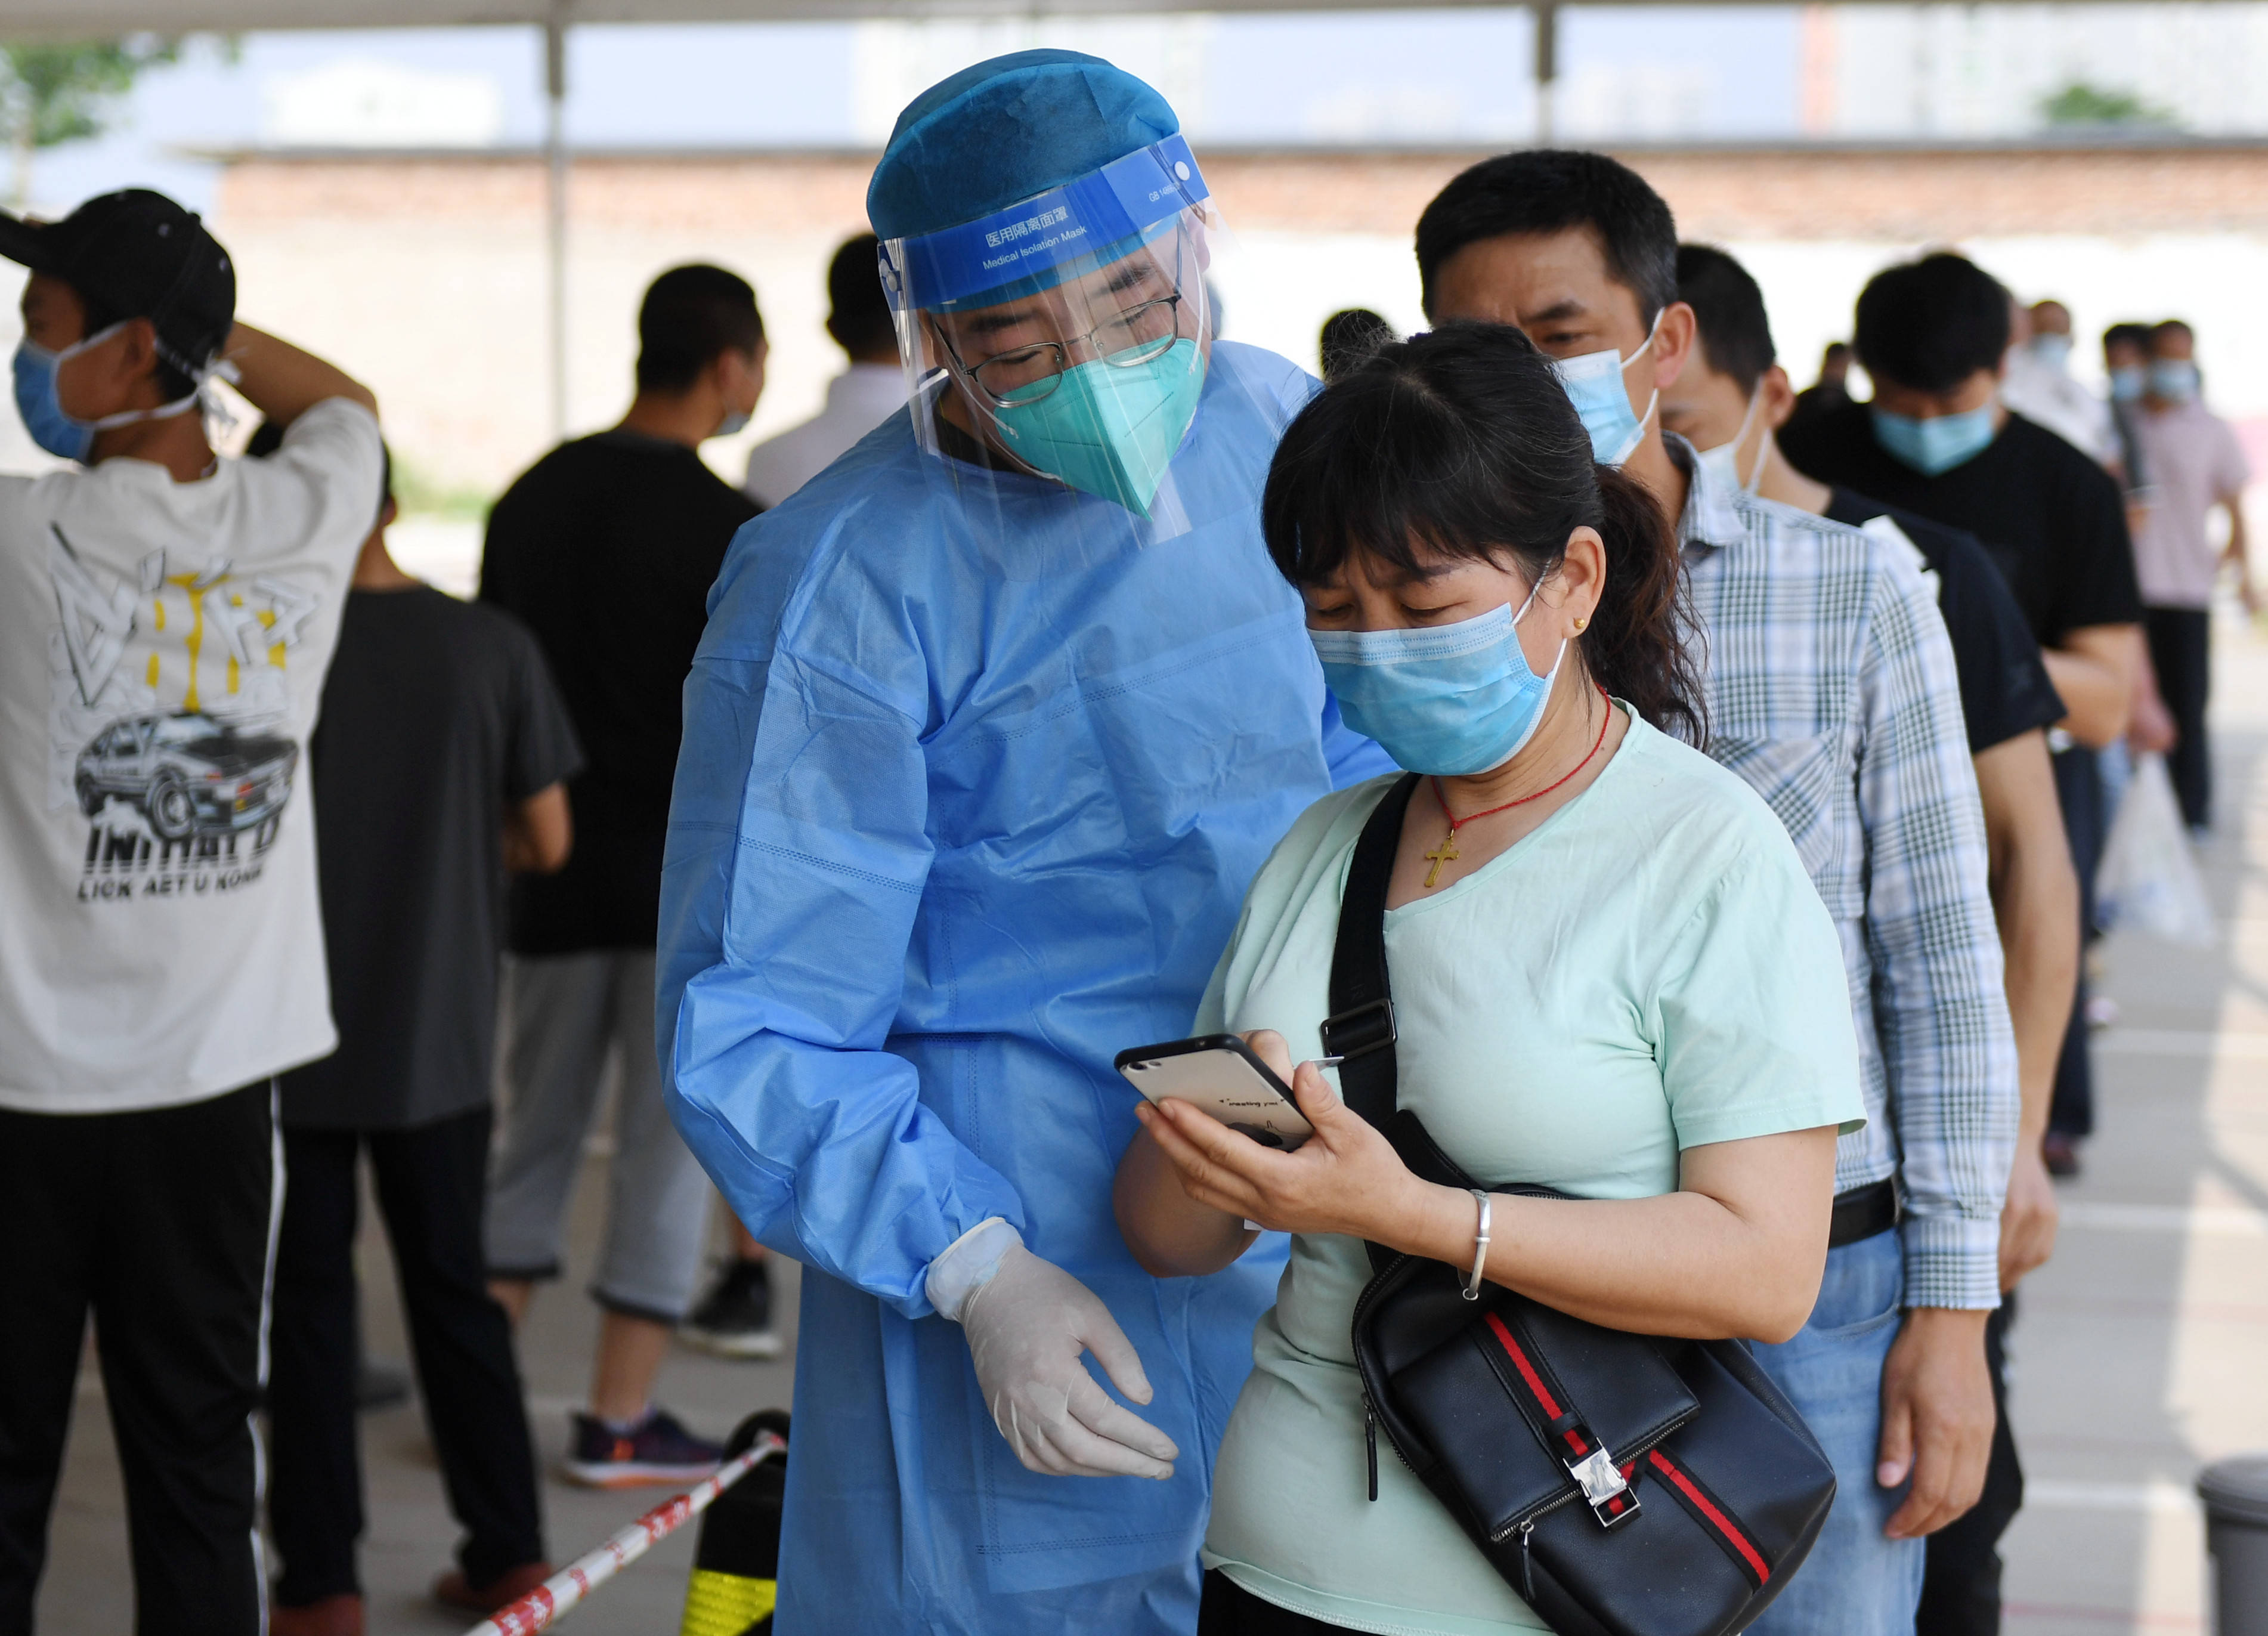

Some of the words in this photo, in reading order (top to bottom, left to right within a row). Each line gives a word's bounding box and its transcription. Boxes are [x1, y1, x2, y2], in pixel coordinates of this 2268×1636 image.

[1149, 191, 1160, 202] GB
[982, 250, 1019, 270] Medical
[1020, 236, 1060, 257] Isolation
[1060, 225, 1087, 242] Mask
[985, 206, 1069, 248] 医用隔离面罩
